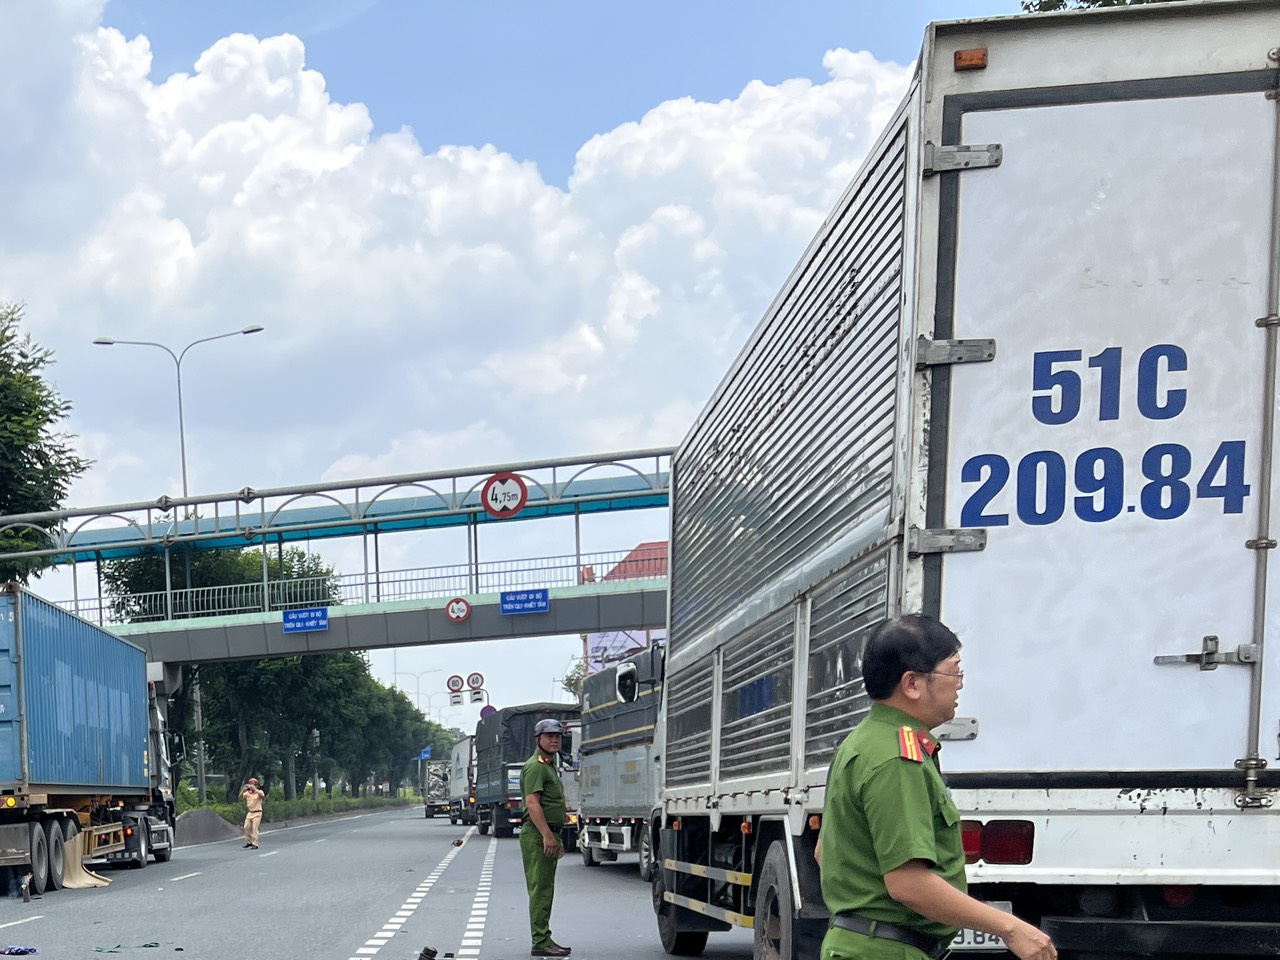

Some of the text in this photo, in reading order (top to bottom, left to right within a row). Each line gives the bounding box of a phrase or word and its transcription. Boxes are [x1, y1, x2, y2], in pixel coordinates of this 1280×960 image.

[1031, 343, 1188, 425] 51C
[491, 486, 519, 504] 4,75m
[960, 440, 1251, 528] 209.84
